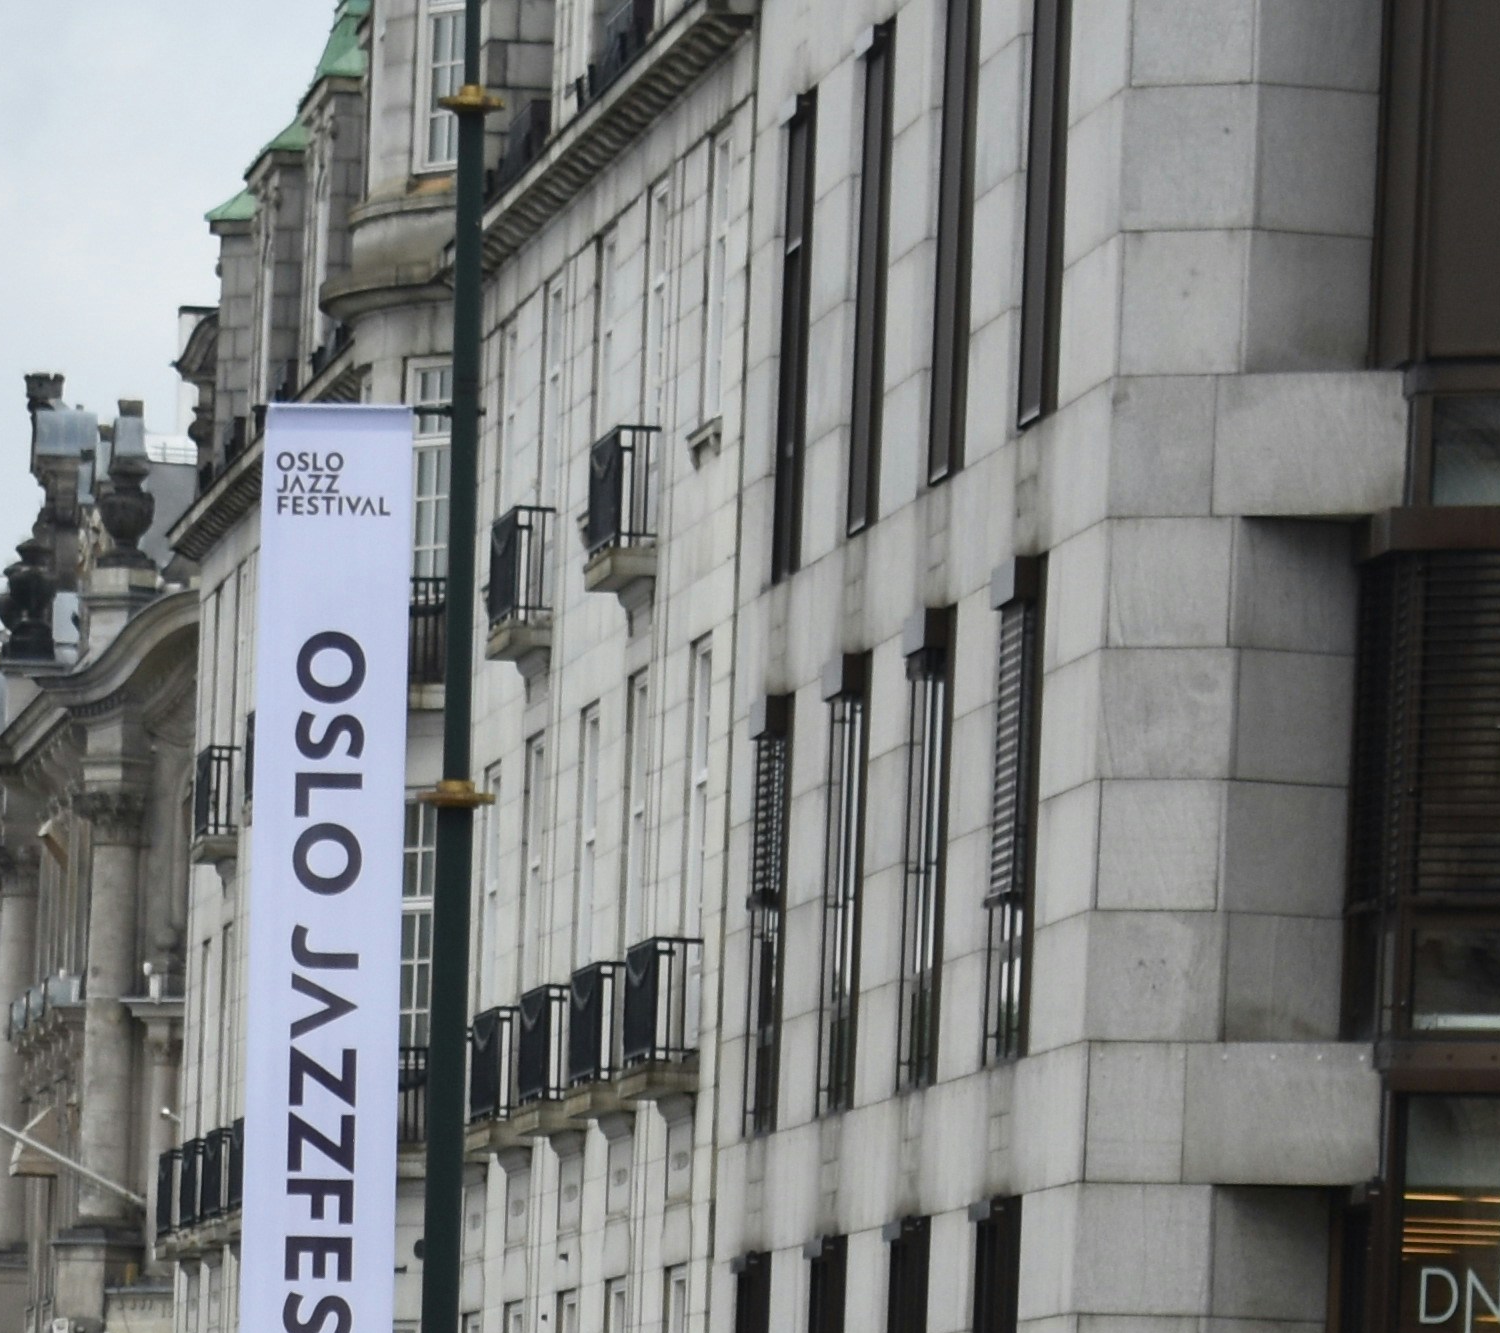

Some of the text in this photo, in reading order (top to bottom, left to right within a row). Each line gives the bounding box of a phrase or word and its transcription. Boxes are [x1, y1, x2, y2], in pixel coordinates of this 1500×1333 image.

[276, 451, 344, 472] OSLO
[276, 474, 340, 493] JAZZ
[276, 495, 391, 516] FESTIVAL
[291, 631, 366, 897] OSLO
